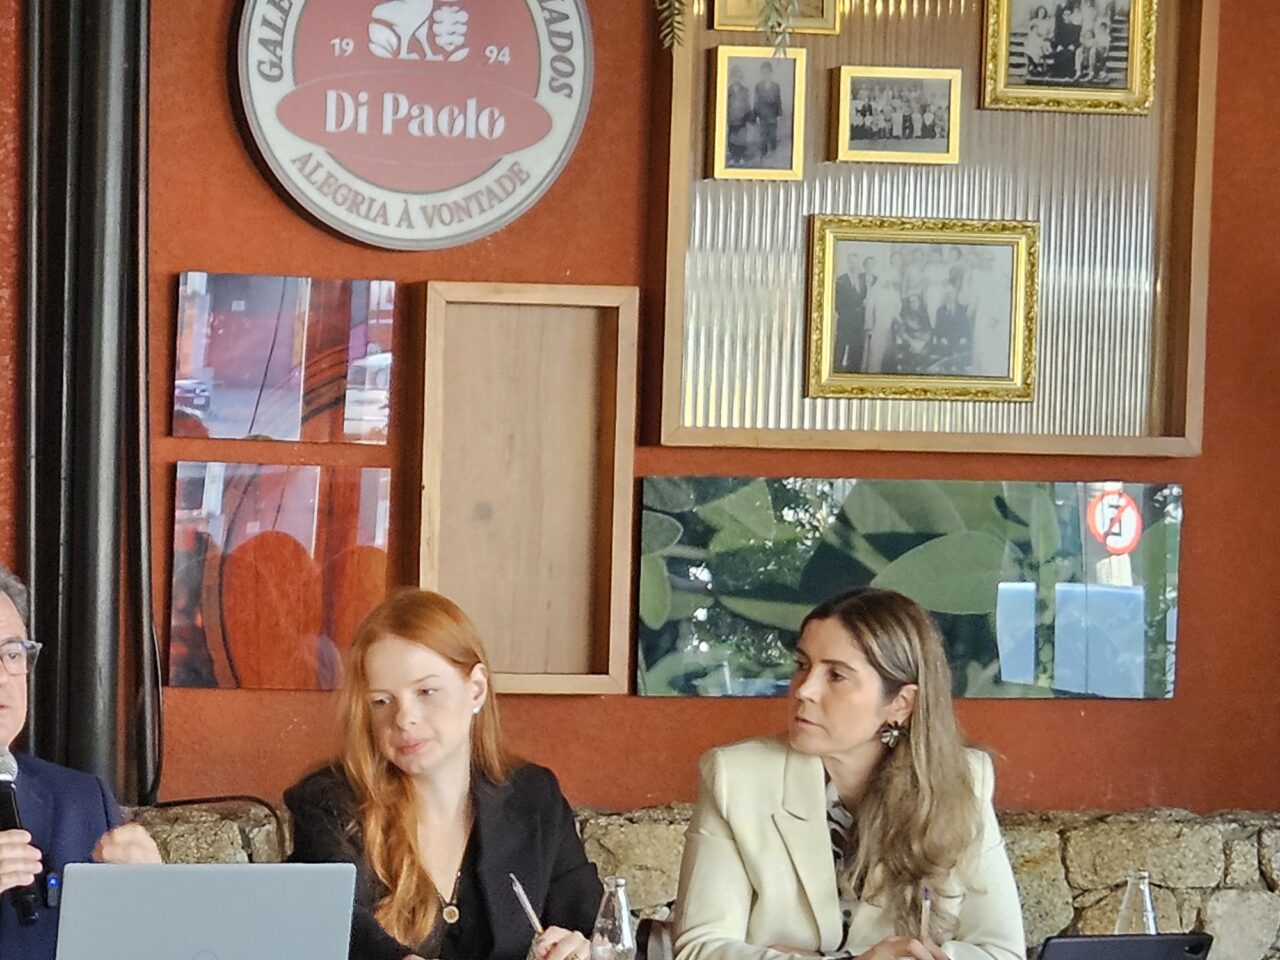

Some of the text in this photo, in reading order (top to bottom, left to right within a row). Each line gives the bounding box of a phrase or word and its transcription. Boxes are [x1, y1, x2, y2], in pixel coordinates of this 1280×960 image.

[330, 37, 511, 65] 19 94
[539, 0, 576, 99] ADOS
[325, 90, 506, 140] Di Paolo
[290, 151, 531, 229] ALEGRIA À VONTADE
